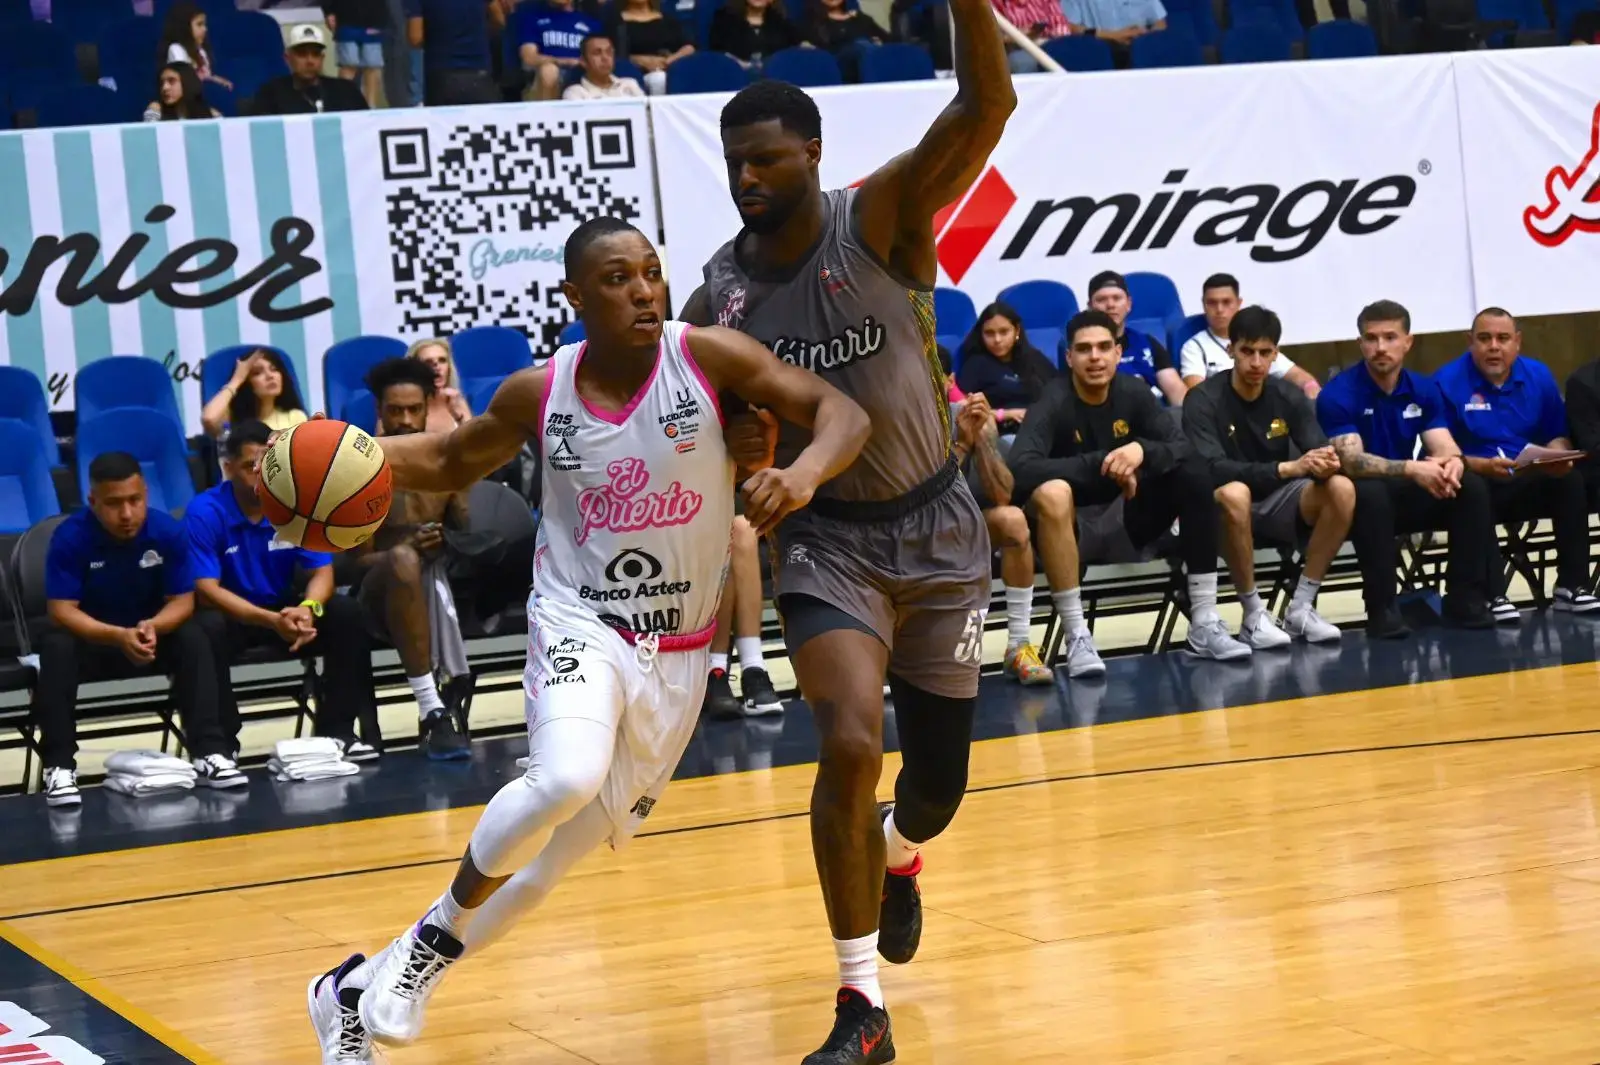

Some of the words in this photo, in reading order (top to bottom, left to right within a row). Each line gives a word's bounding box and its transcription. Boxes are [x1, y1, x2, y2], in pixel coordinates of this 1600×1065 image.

[1000, 169, 1417, 263] mirage
[0, 204, 335, 323] nier
[47, 373, 70, 405] y
[607, 457, 649, 500] El
[574, 481, 702, 547] Puerto
[579, 585, 631, 602] Banco
[634, 580, 691, 599] Azteca
[543, 674, 586, 688] MEGA
